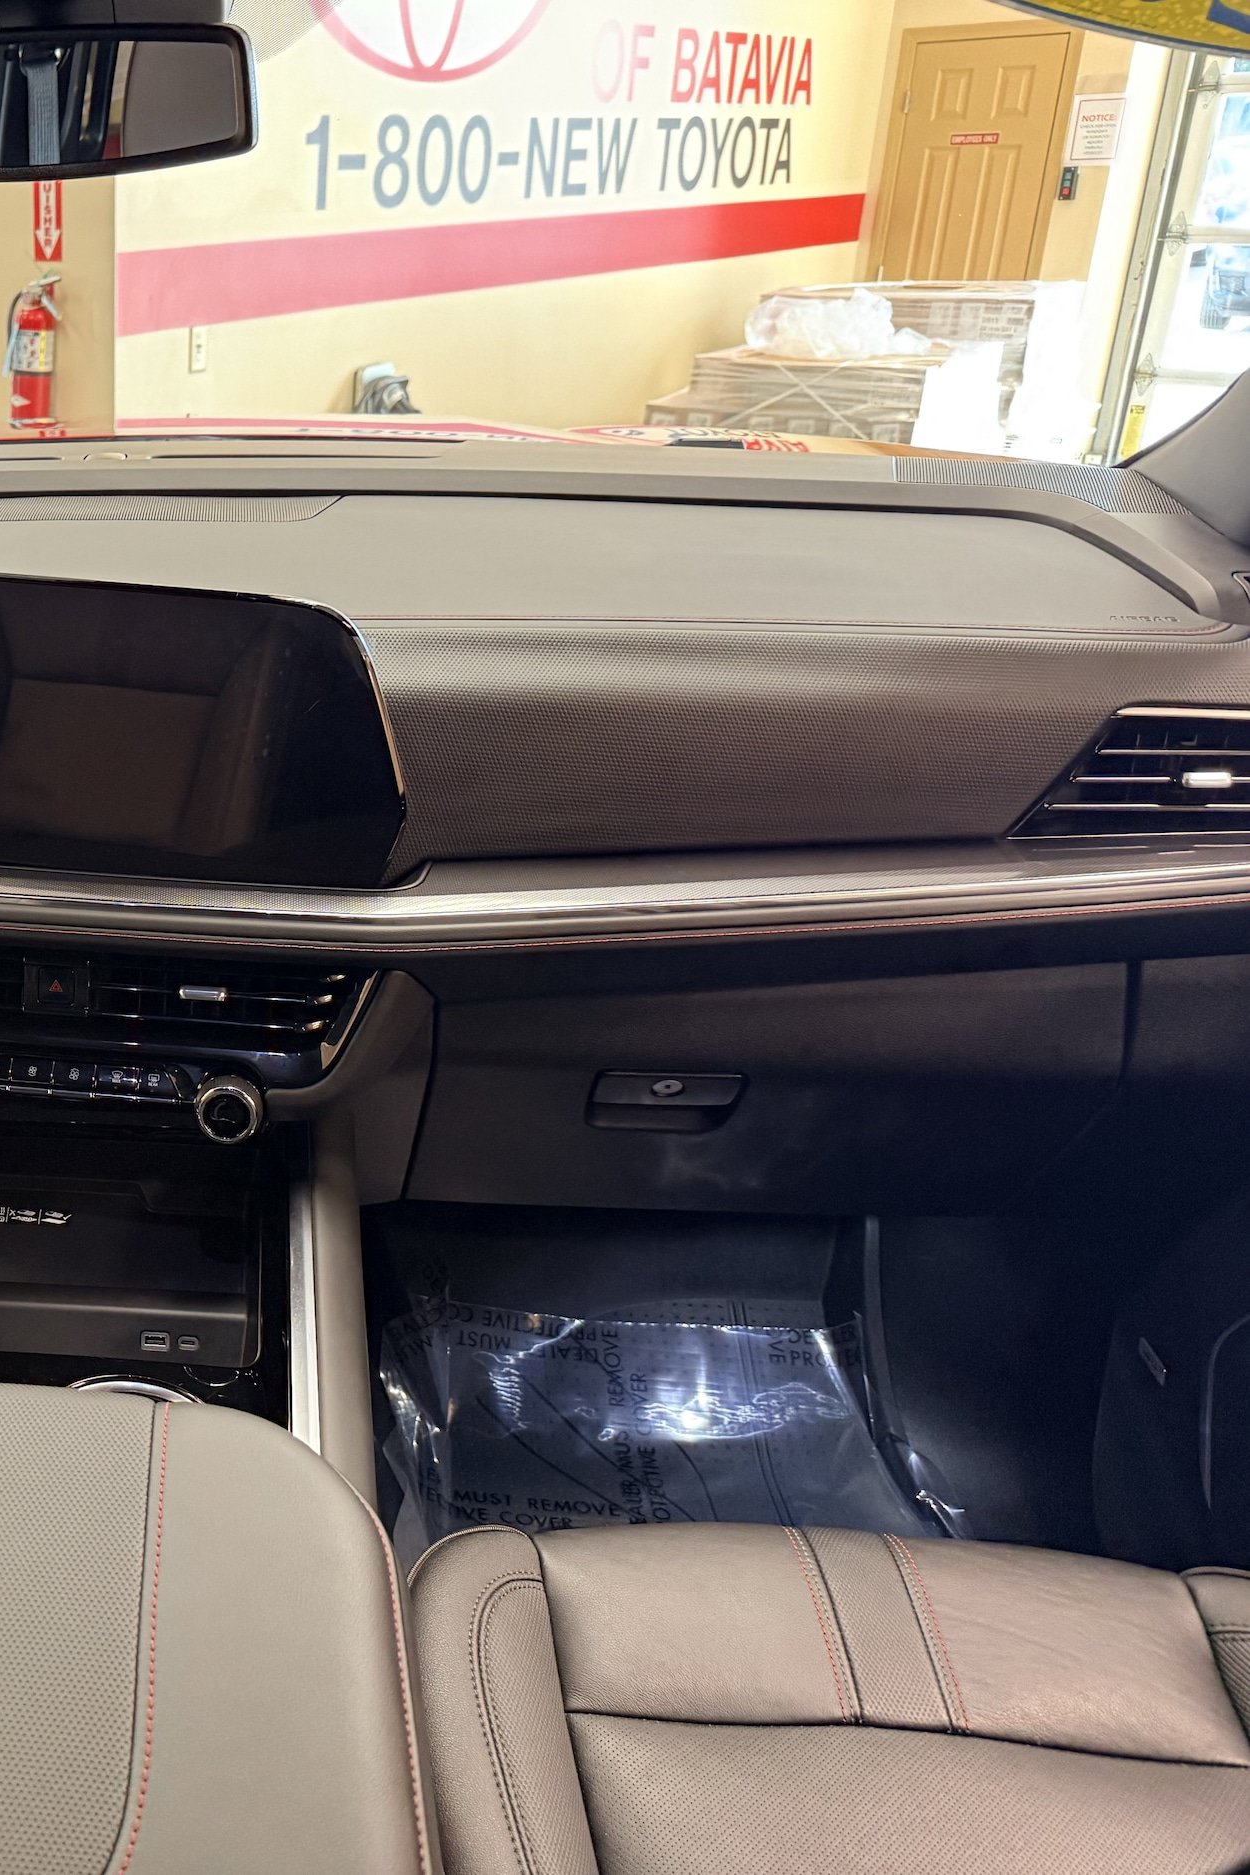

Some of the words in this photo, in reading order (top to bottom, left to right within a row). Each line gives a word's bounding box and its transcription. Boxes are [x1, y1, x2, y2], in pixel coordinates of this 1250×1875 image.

[592, 19, 655, 103] OF
[670, 28, 812, 105] BATAVIA
[305, 114, 638, 211] 1-800-NEW
[656, 115, 791, 192] TOYOTA
[951, 135, 982, 144] EMPLOYEES
[983, 134, 997, 142] ONLY
[457, 1329, 511, 1350] MUST
[601, 1327, 626, 1407] REMOVE
[630, 1372, 652, 1437] COVER
[453, 1488, 513, 1506] MUST
[527, 1497, 621, 1518] REMOVE
[500, 1510, 573, 1531] COVER
